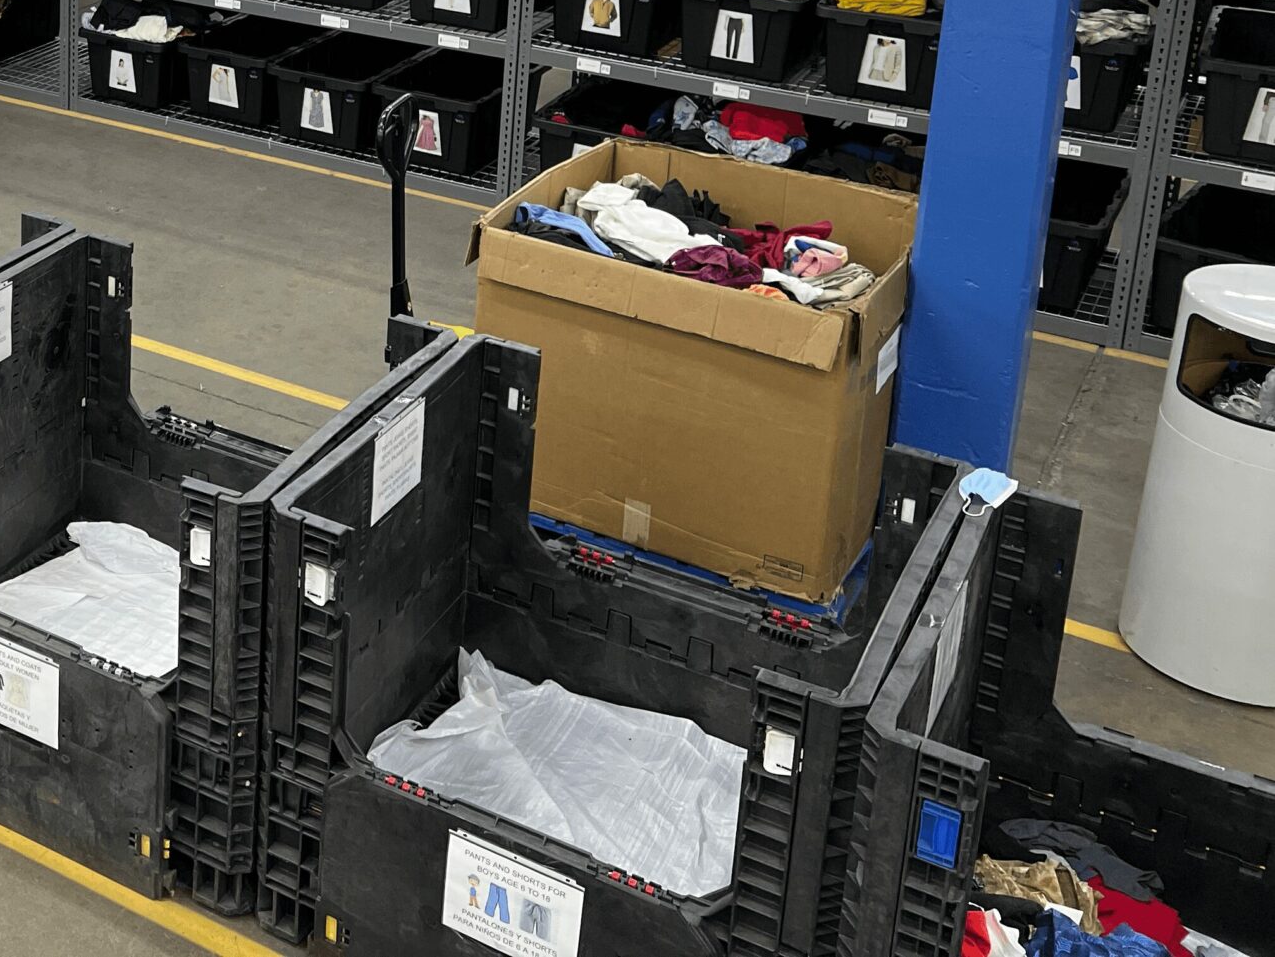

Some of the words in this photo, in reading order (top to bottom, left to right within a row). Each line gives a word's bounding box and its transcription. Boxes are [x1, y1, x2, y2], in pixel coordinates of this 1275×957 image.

[7, 655, 20, 664] AND
[21, 660, 42, 673] COATS
[465, 849, 491, 865] PANTS
[492, 861, 511, 874] AND
[512, 870, 547, 890] SHORTS
[548, 885, 566, 899] FOR
[477, 865, 500, 880] BOYS
[501, 877, 519, 889] AGE
[520, 884, 526, 892] 6
[528, 887, 540, 898] TO
[541, 894, 551, 903] 18
[453, 913, 474, 929] PARA
[475, 924, 501, 942] NIÑOS
[502, 937, 515, 947] DE
[462, 908, 515, 937] PANTALONES
[523, 936, 558, 957] SHORTS
